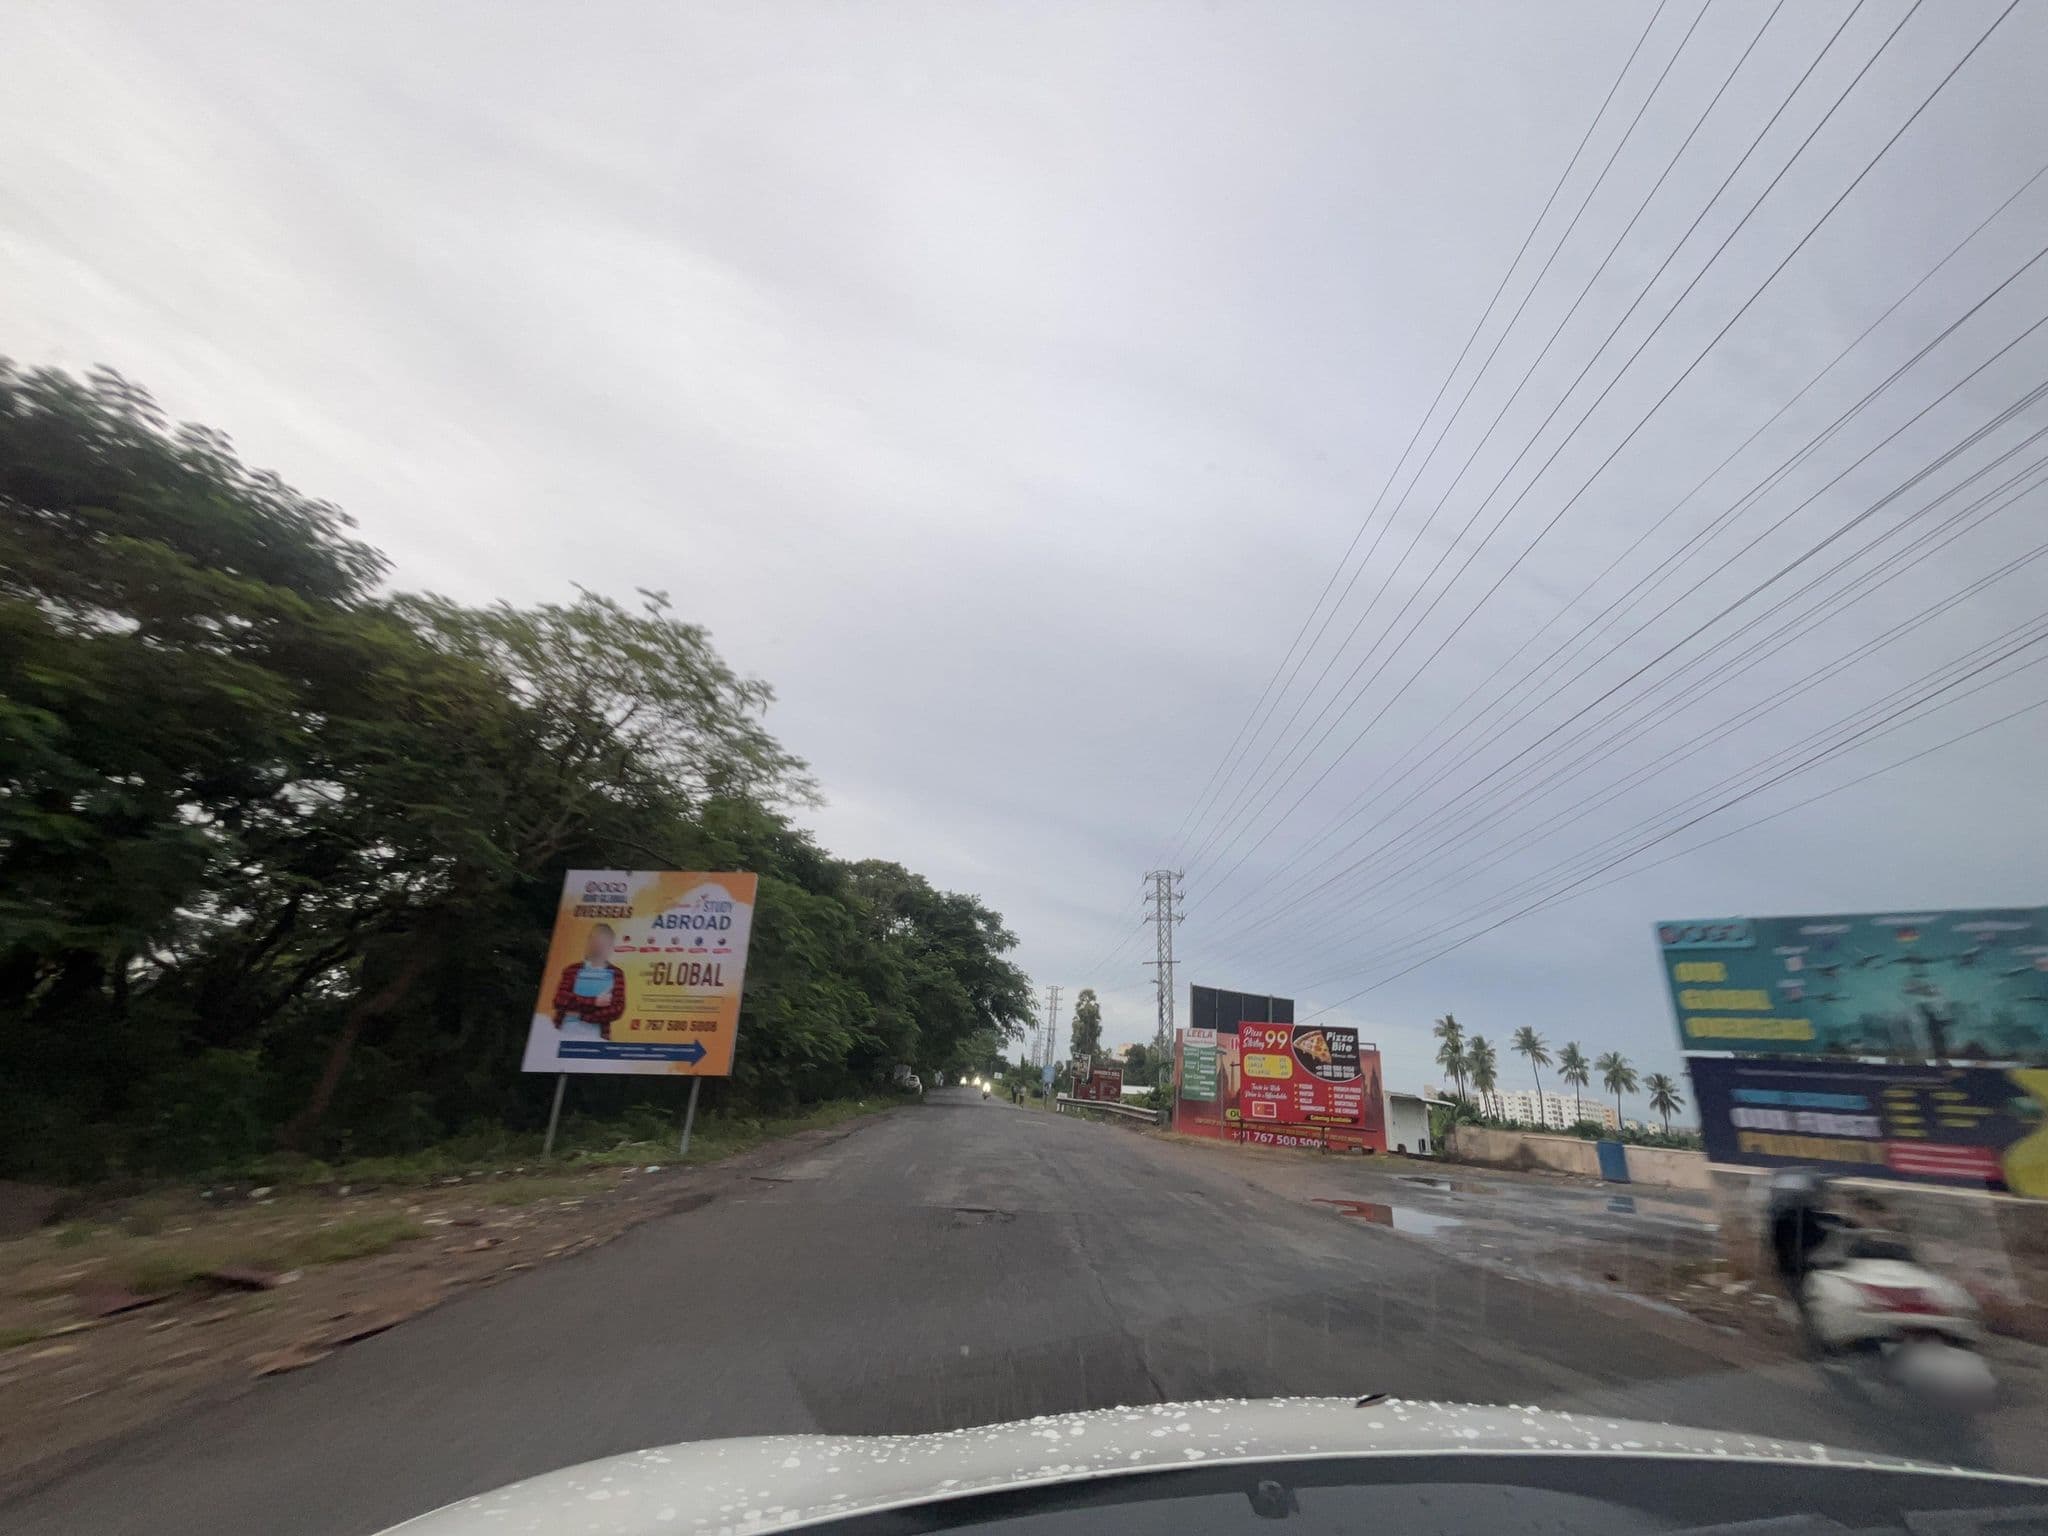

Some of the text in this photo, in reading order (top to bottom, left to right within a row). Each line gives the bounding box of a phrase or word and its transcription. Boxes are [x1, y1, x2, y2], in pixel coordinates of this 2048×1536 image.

[703, 901, 734, 913] STUDY
[652, 914, 732, 930] ABROAD
[652, 962, 724, 987] GLOBAL
[1265, 1030, 1288, 1050] 99
[1326, 1032, 1354, 1043] Pizza
[1332, 1042, 1352, 1052] Bite
[1254, 1132, 1274, 1143] 767
[1276, 1136, 1297, 1146] 500
